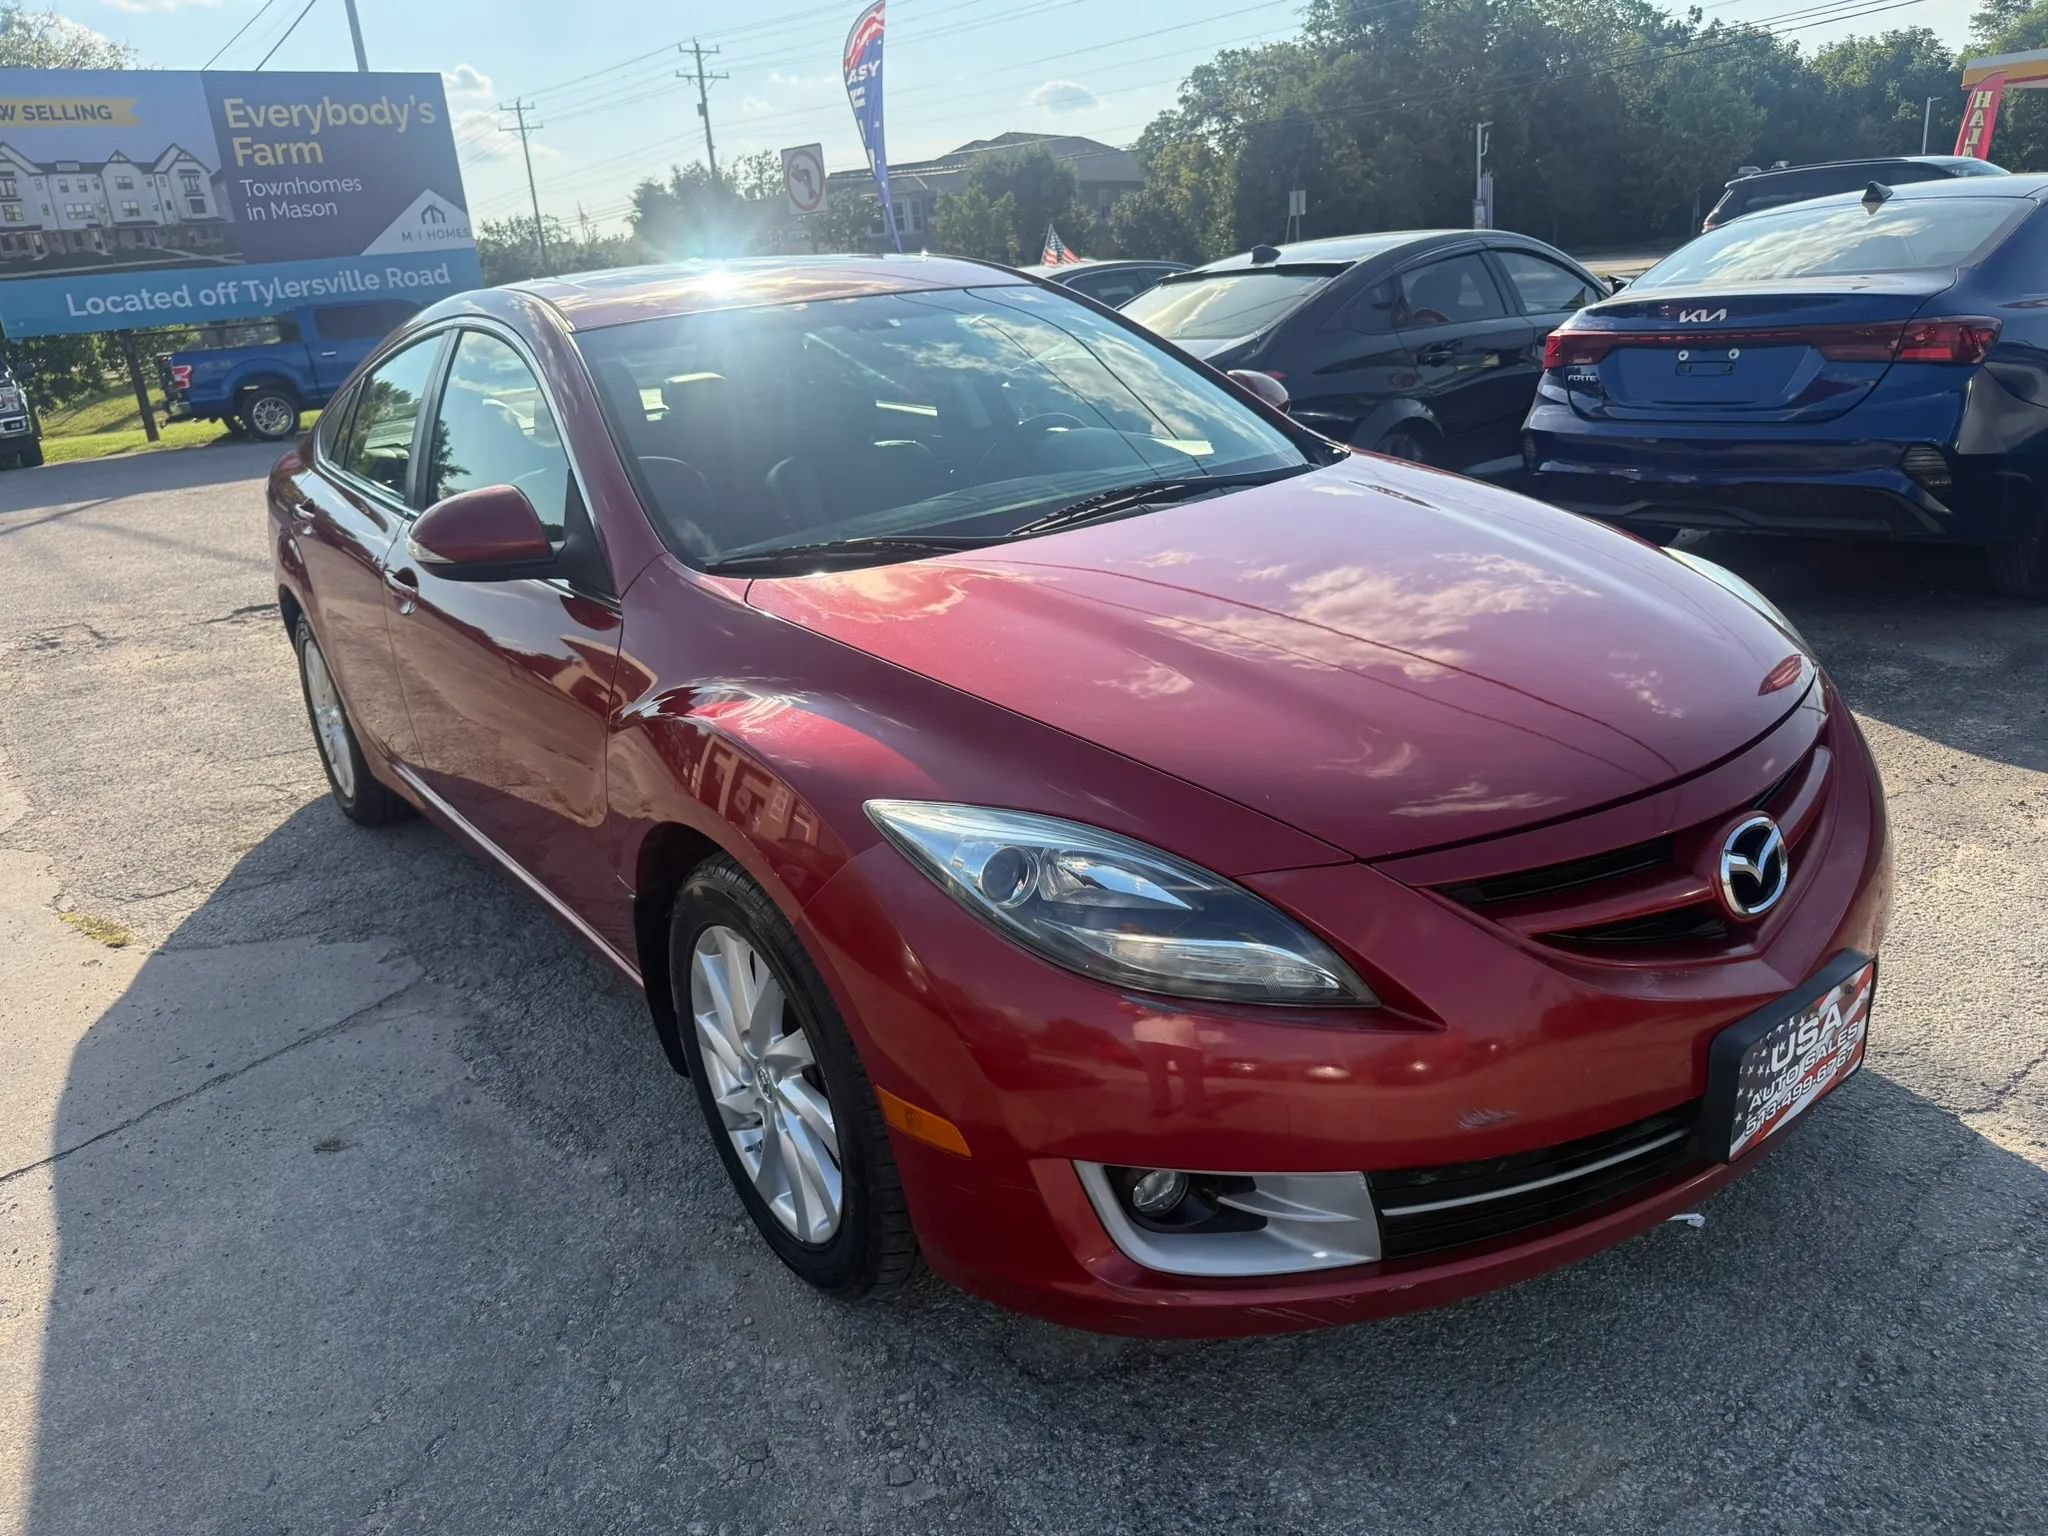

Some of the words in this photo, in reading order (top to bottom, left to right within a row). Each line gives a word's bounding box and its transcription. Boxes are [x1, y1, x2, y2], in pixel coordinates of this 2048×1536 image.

[22, 105, 112, 120] SELLING
[224, 95, 436, 135] Everybody's
[232, 137, 324, 167] Farm
[240, 177, 362, 197] Townhomes
[246, 203, 266, 221] in
[271, 201, 338, 219] Mason
[66, 284, 192, 317] Located
[200, 281, 239, 306] off
[242, 270, 380, 307] Tylersville
[386, 263, 451, 288] Road
[1679, 309, 1727, 323] KIA
[1771, 1003, 1842, 1072] USA
[1748, 1065, 1799, 1112] AUTO
[1804, 1021, 1858, 1072] SALES
